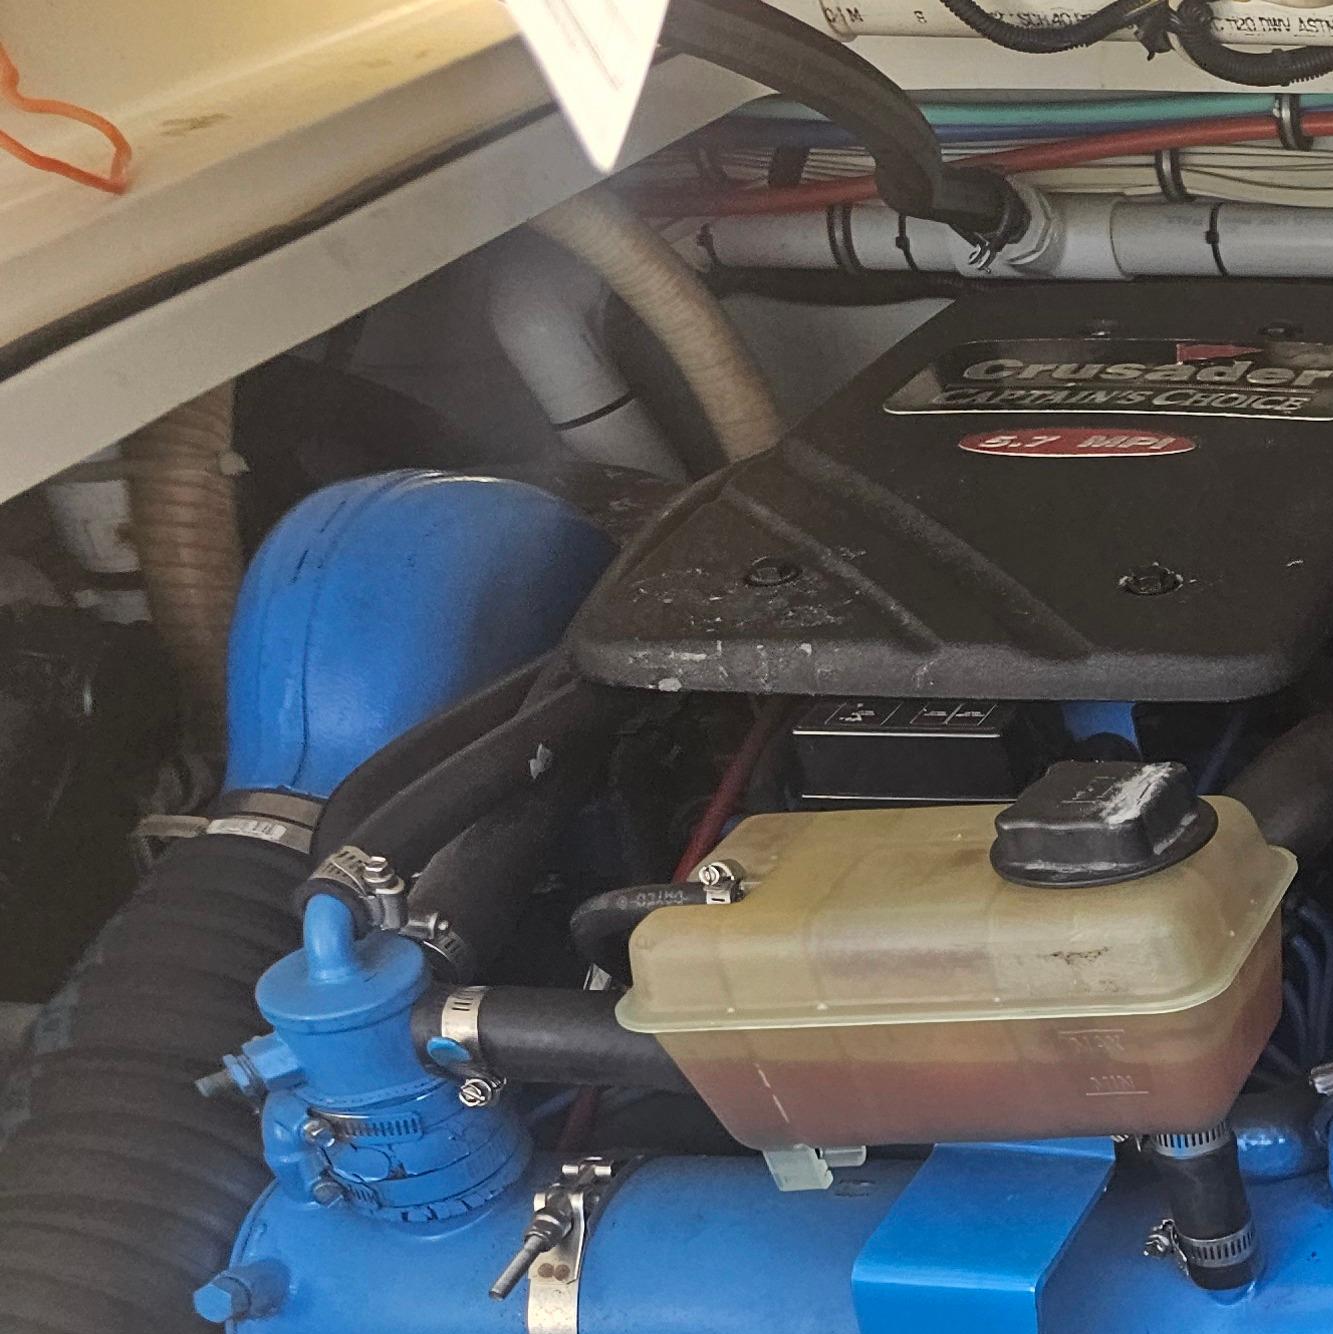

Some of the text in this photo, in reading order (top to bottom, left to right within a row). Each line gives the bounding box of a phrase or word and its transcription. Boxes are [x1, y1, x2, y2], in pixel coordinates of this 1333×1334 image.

[933, 388, 1311, 411] CAPTAIN'S CHOICE
[978, 434, 1178, 450] 5.7 MPI
